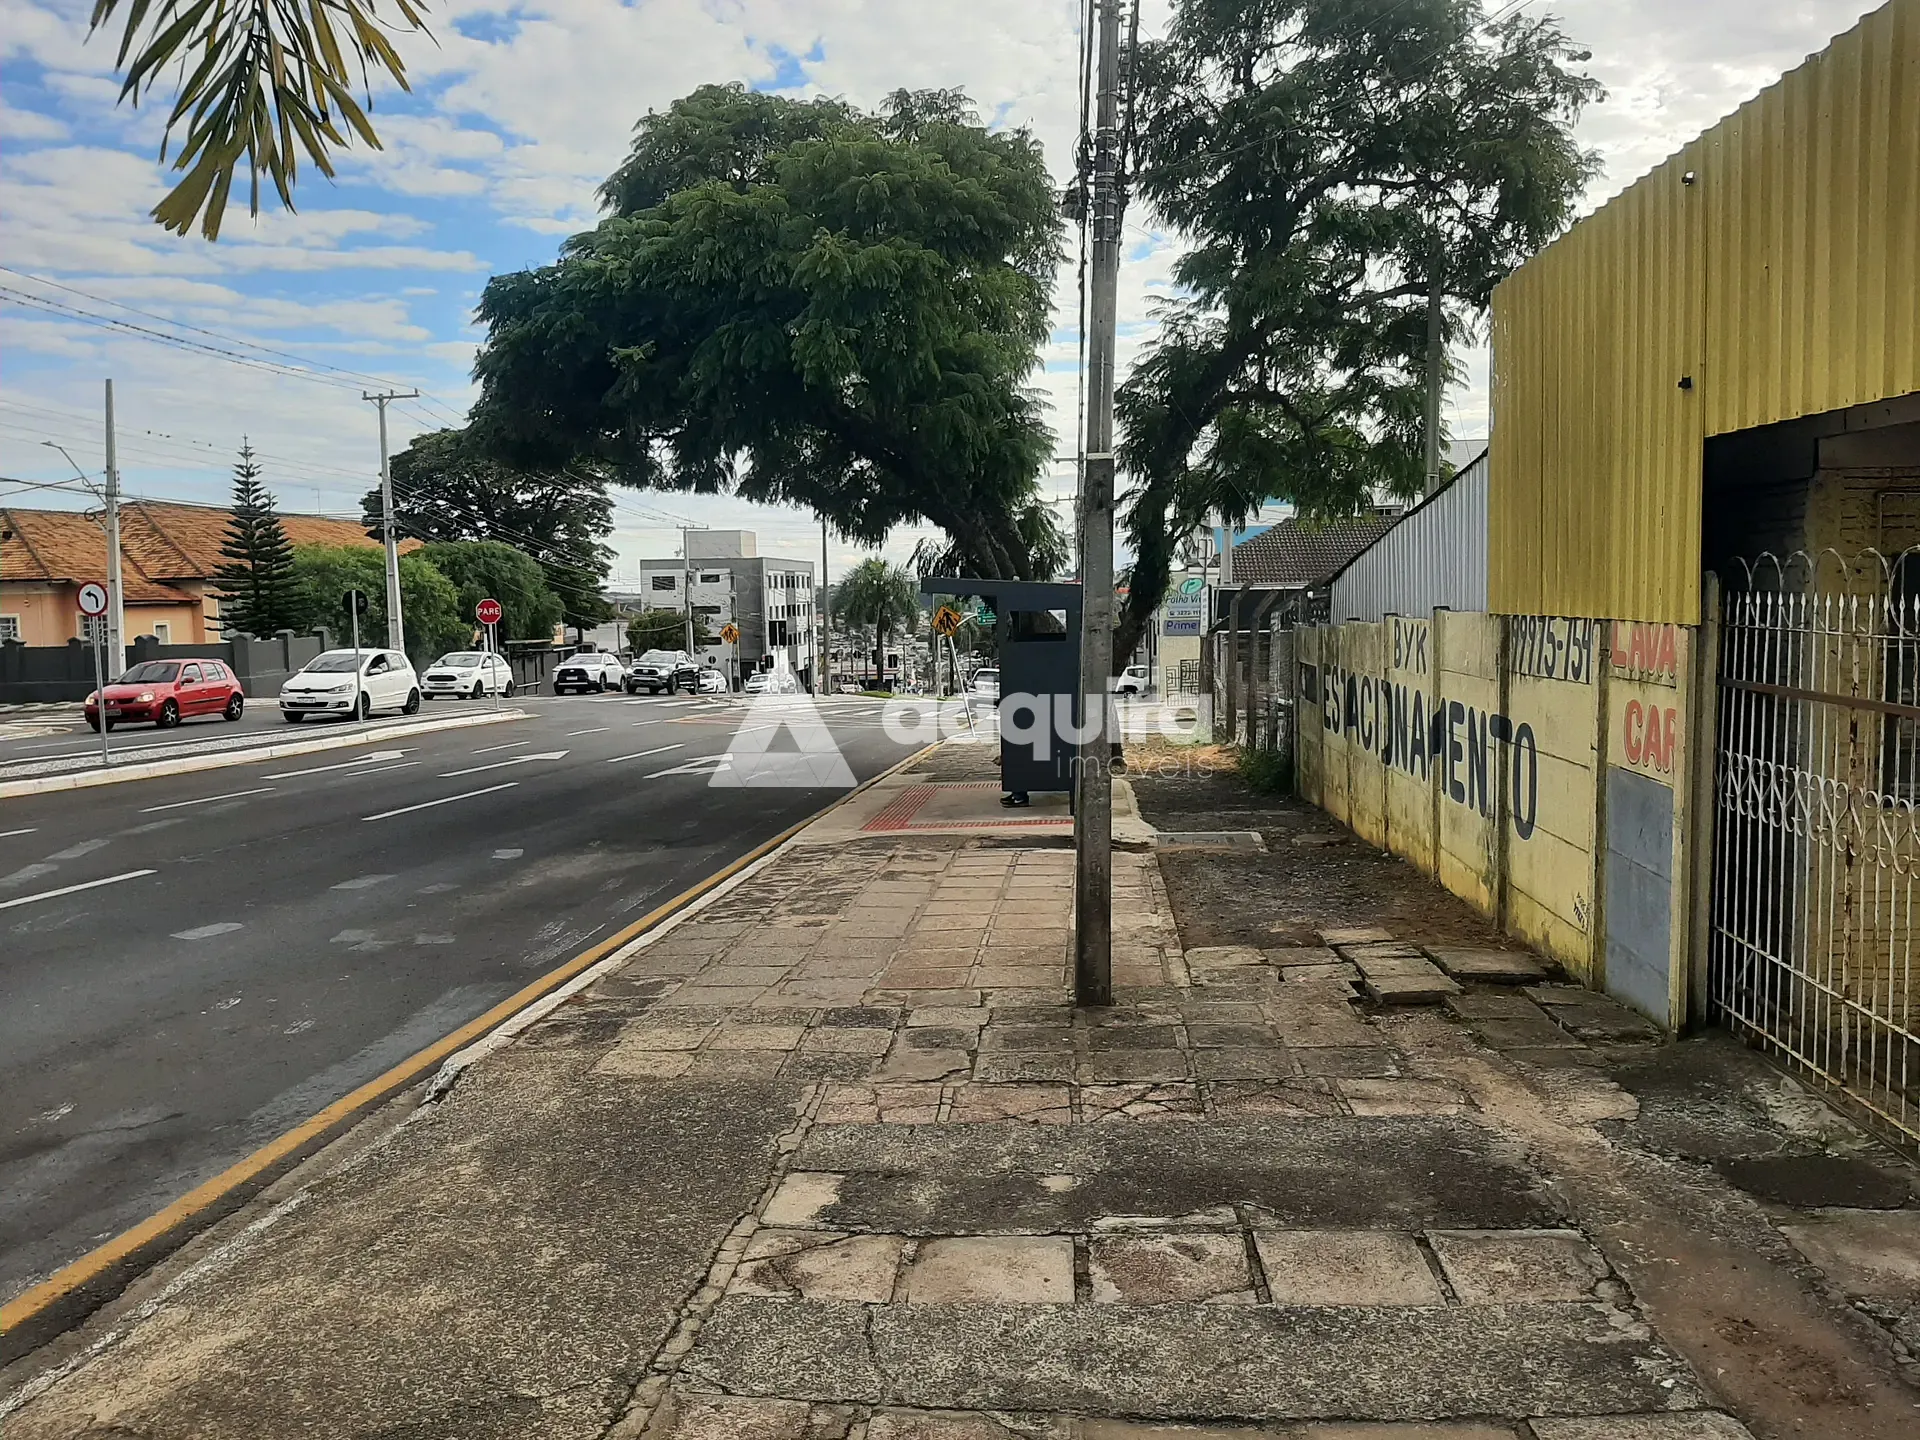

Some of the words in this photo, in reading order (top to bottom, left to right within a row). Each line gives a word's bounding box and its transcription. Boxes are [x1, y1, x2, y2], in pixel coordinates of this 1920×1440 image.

[477, 607, 500, 616] PARE
[1166, 620, 1197, 631] Prime
[1394, 618, 1427, 675] BYK
[1610, 620, 1677, 679] LAVA
